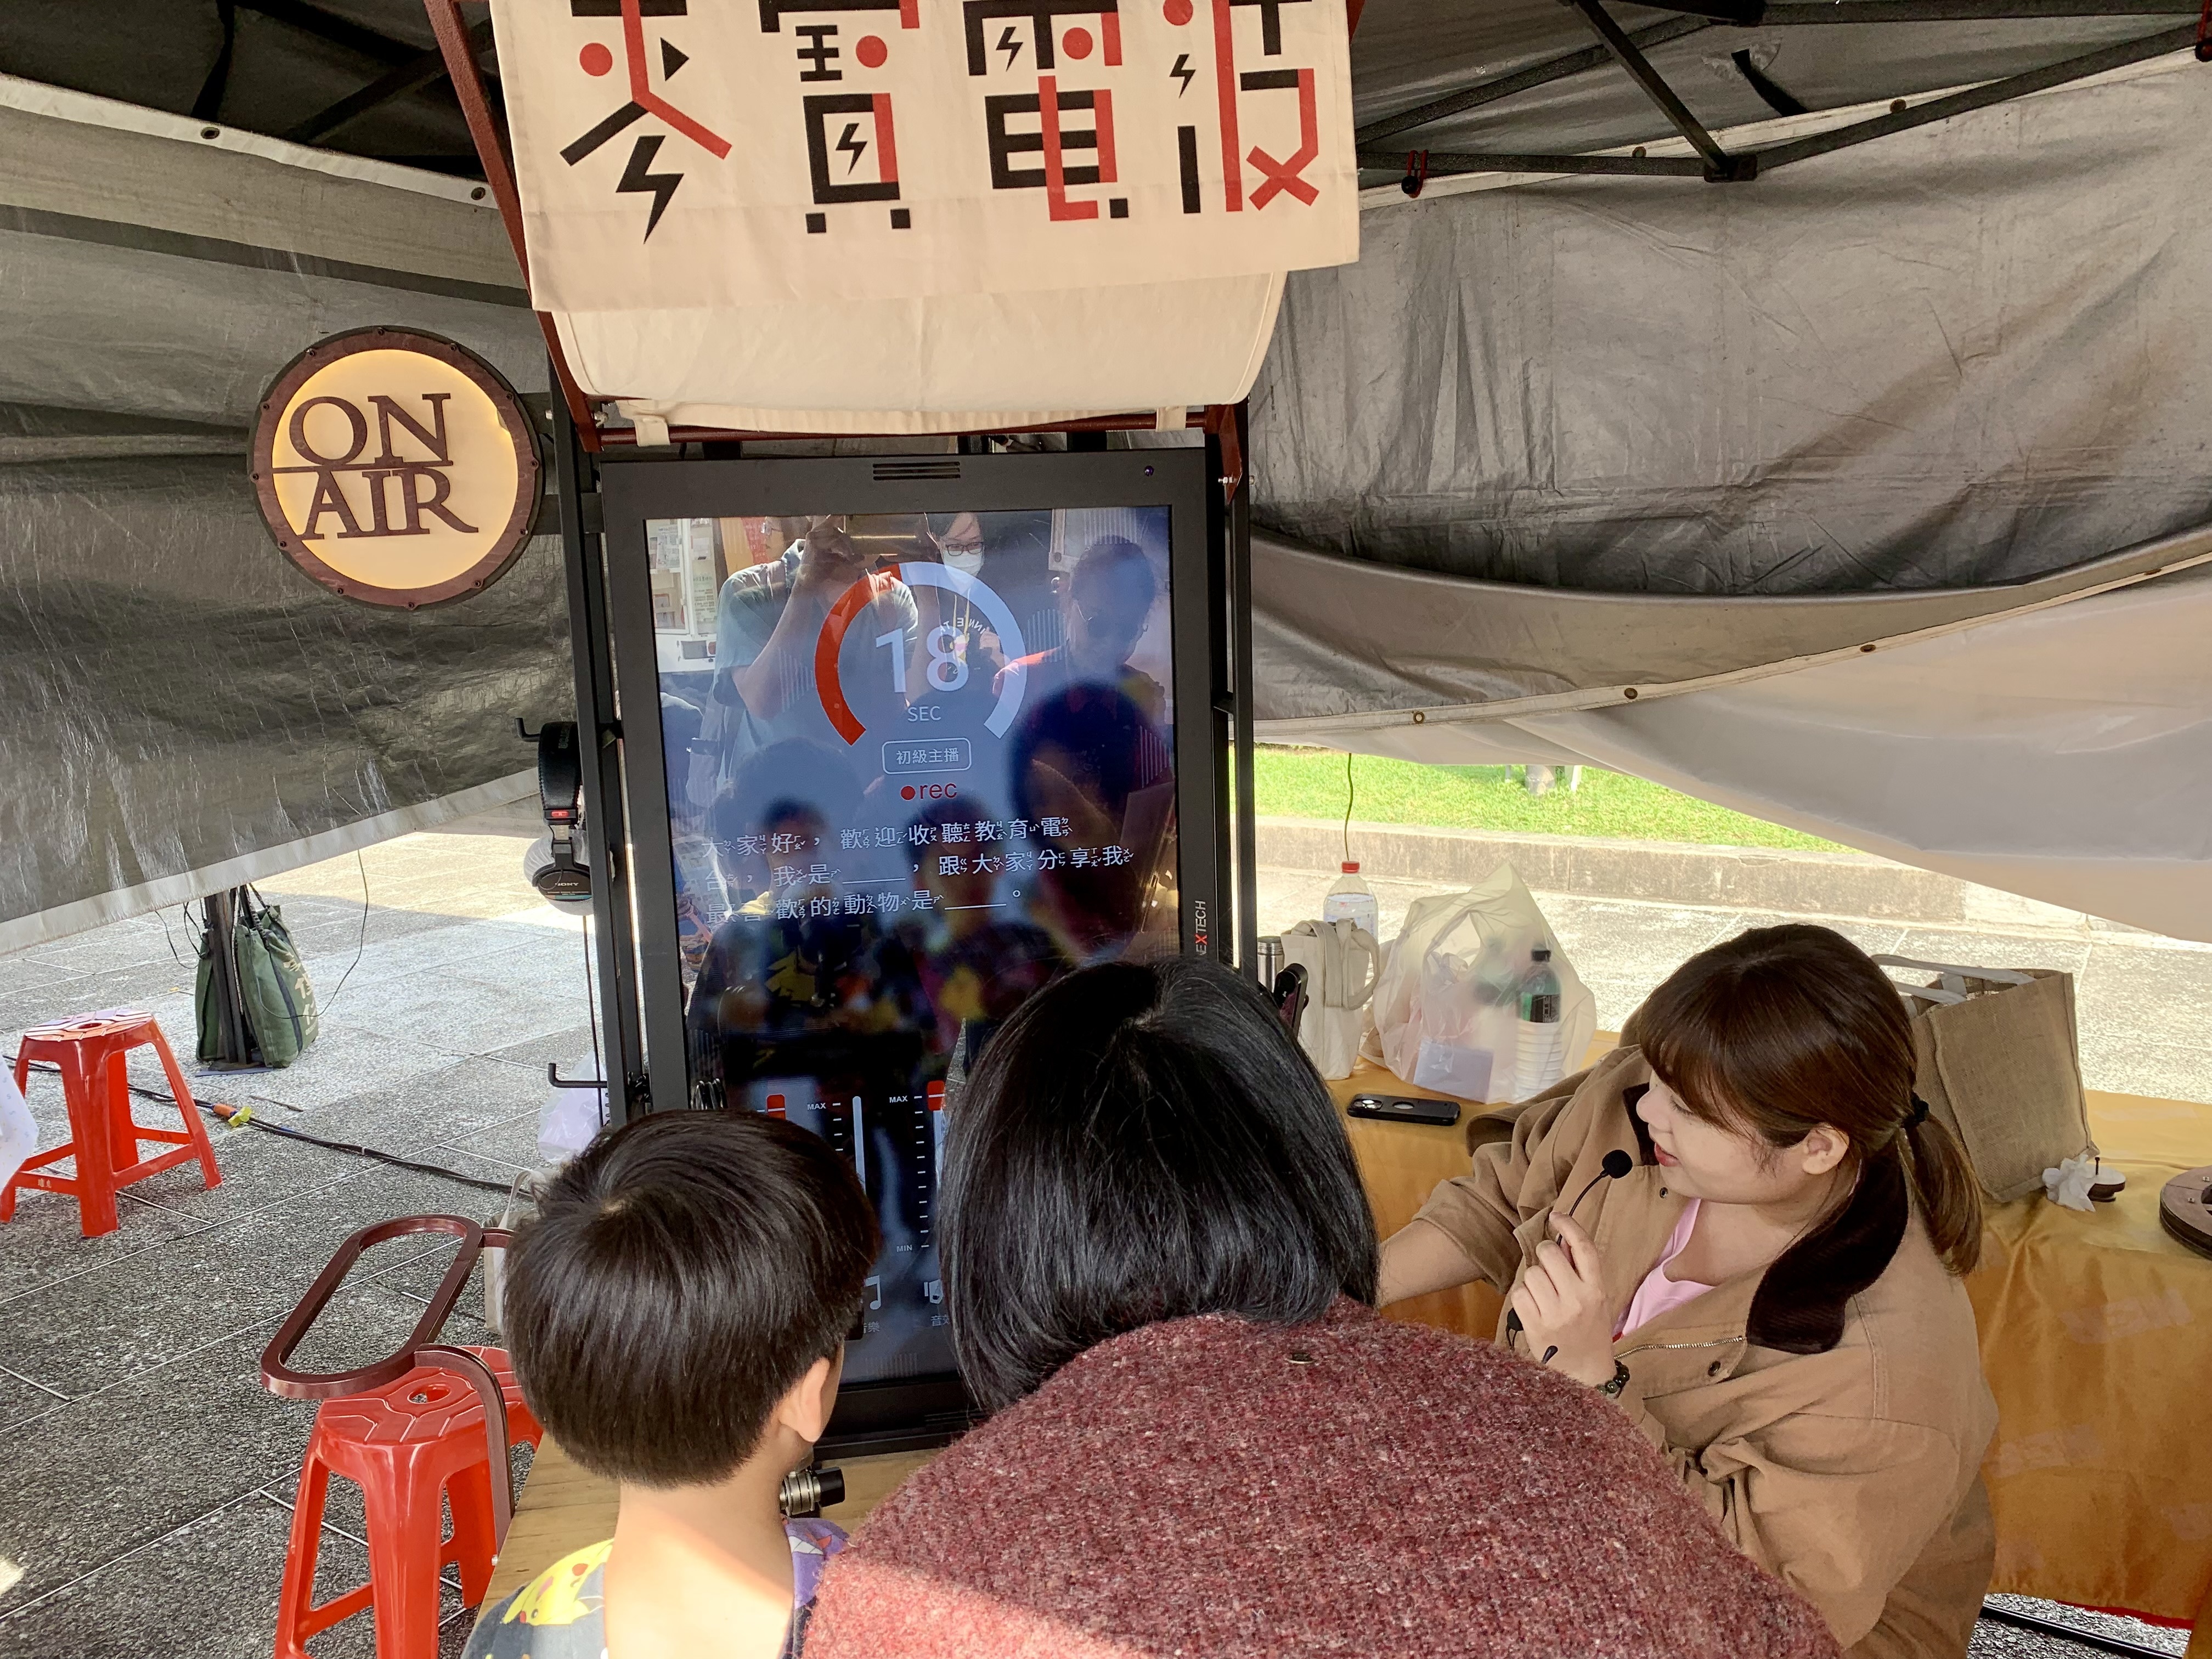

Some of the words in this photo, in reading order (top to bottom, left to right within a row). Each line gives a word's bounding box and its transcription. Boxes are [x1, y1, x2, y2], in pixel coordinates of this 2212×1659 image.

[289, 393, 453, 466] ON
[298, 467, 479, 540] AIR
[876, 625, 969, 693] 18
[907, 706, 941, 722] SEC
[896, 747, 959, 765] 初級主播
[919, 783, 957, 799] rec
[807, 1102, 826, 1110] MAX
[889, 1095, 908, 1103] MAX
